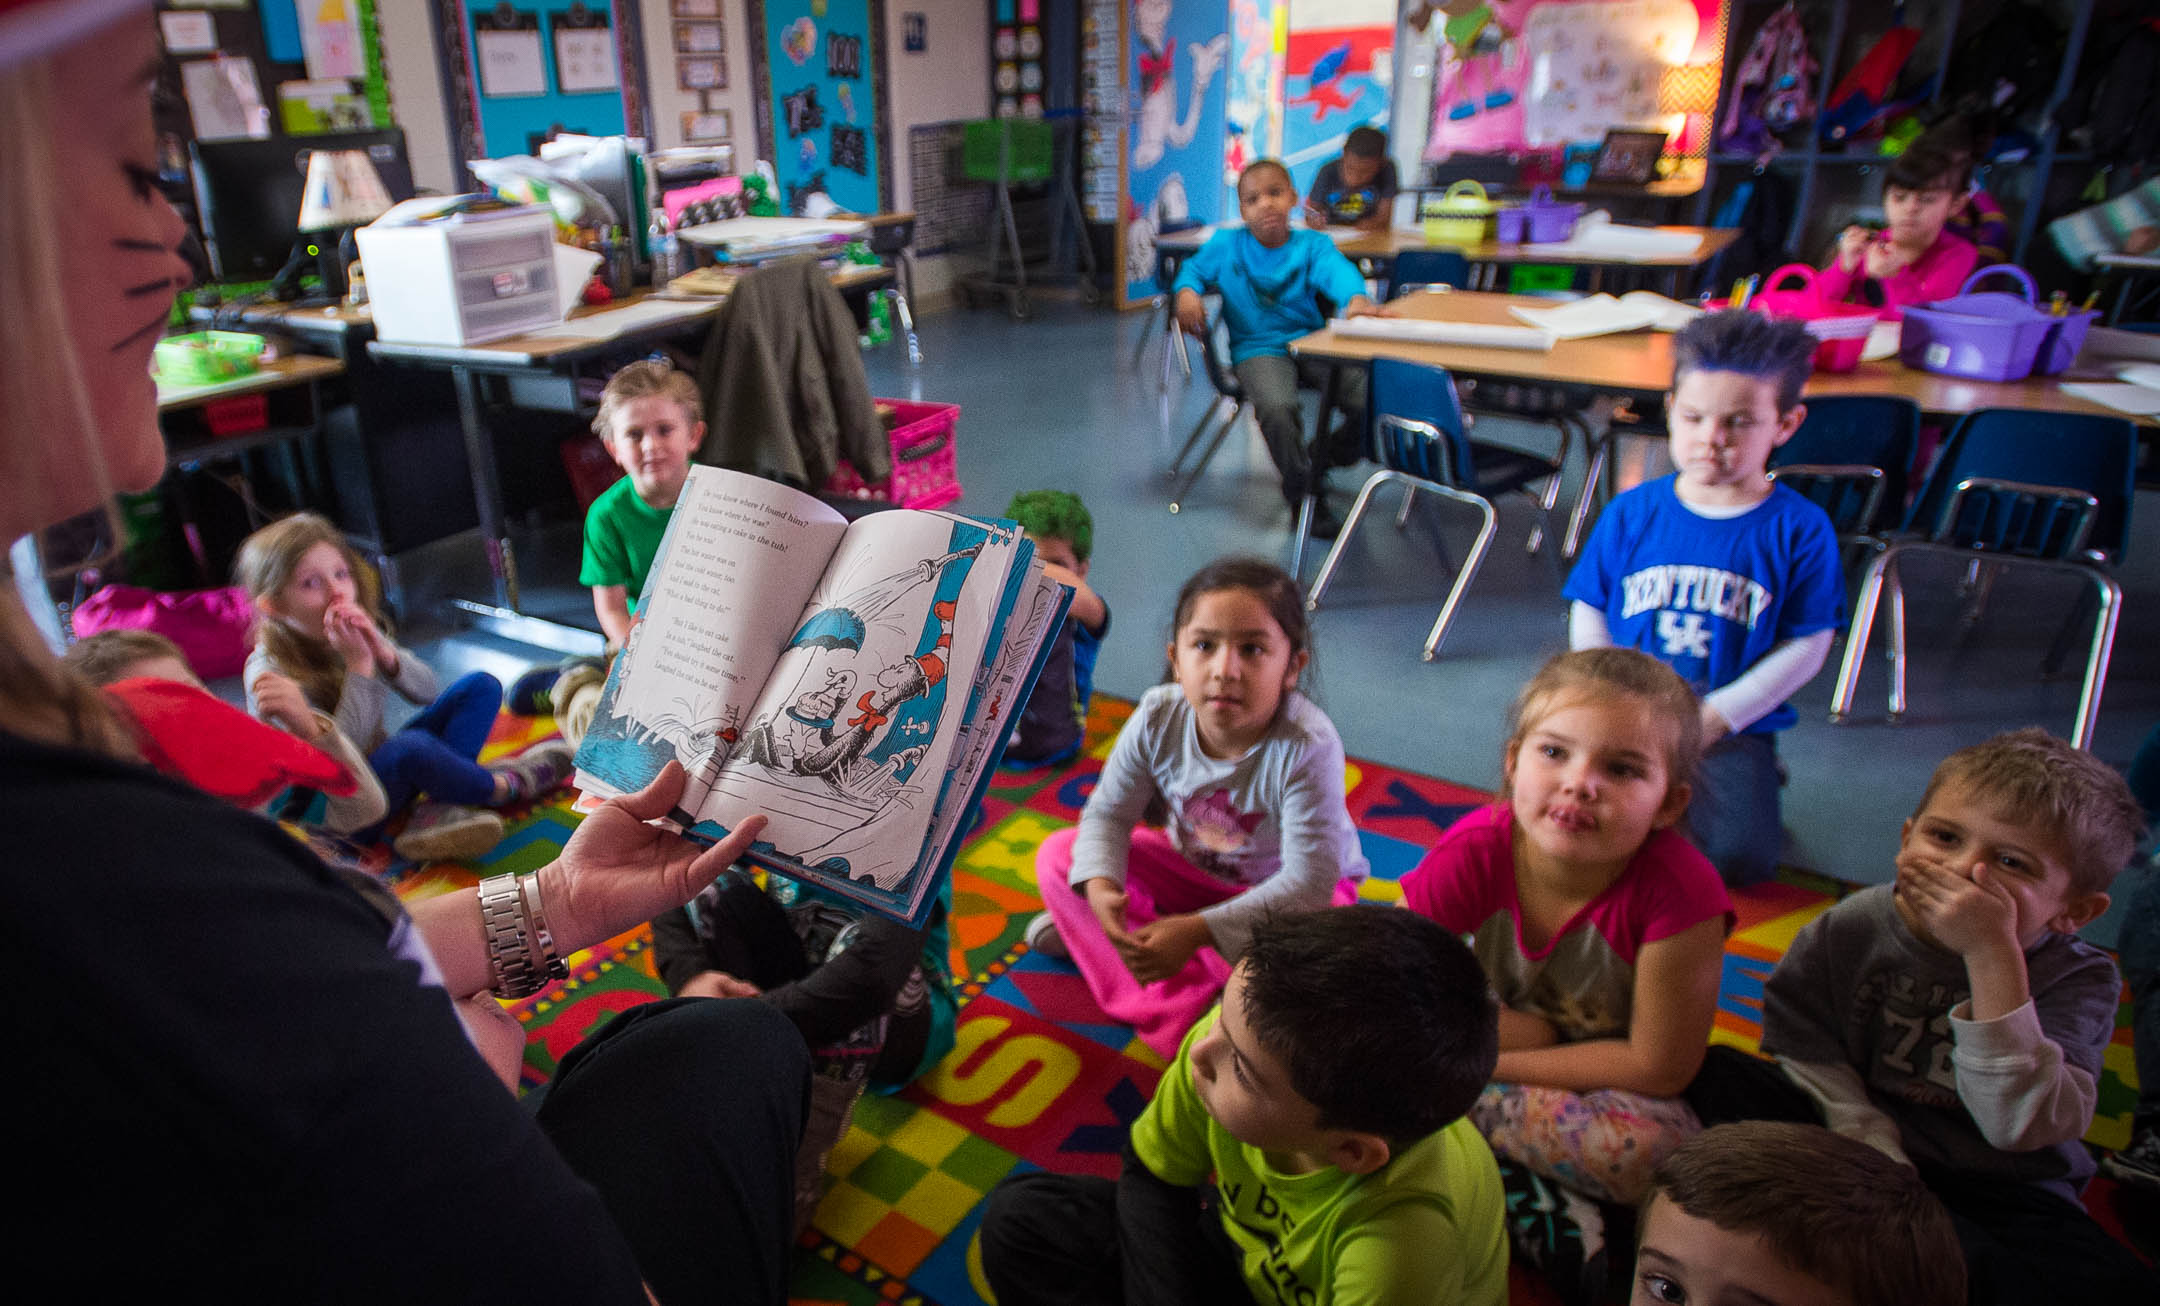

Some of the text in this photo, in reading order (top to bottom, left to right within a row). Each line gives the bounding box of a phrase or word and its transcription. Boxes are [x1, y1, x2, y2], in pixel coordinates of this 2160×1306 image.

[724, 510, 742, 521] where
[752, 518, 770, 529] was?
[739, 498, 758, 509] where
[764, 506, 788, 520] found
[787, 512, 809, 529] him?
[732, 528, 748, 538] cake
[756, 535, 770, 546] the
[770, 540, 789, 553] tub!
[700, 552, 717, 562] water
[716, 556, 728, 564] was
[700, 584, 710, 592] the
[694, 598, 709, 610] thing
[1621, 564, 1773, 631] KENTUCKY
[714, 632, 730, 644] cake
[1657, 610, 1712, 658] UK
[711, 646, 722, 658] the
[705, 664, 722, 674] some
[932, 1015, 1081, 1129] S
